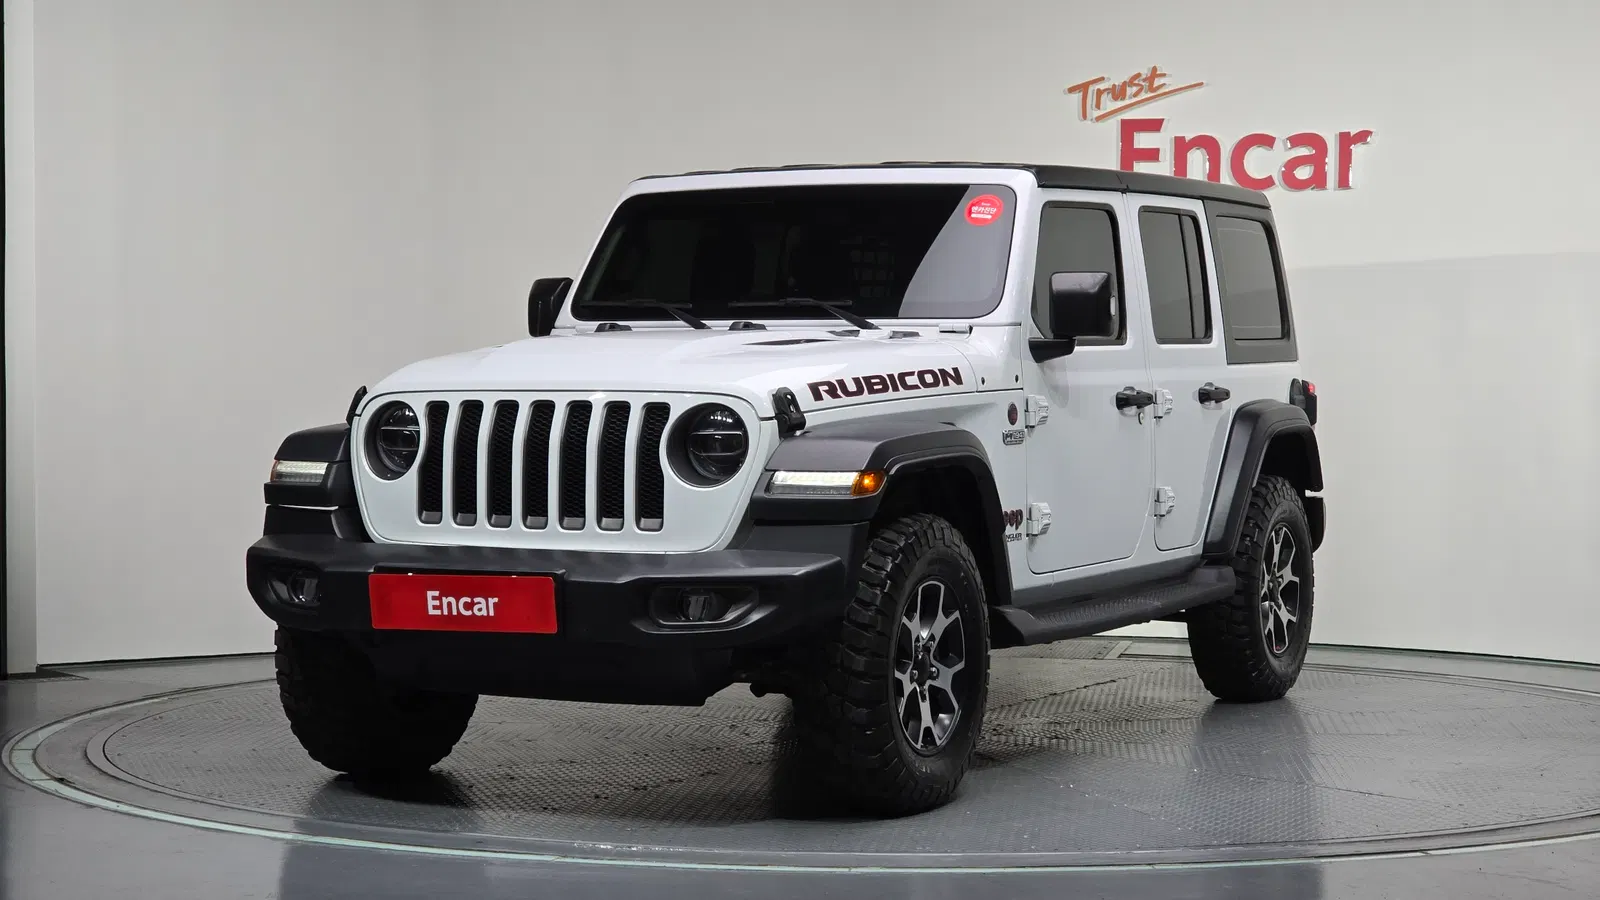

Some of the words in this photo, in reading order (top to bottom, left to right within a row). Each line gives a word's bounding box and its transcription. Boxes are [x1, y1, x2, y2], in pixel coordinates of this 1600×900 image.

[1066, 65, 1168, 121] Trust
[1119, 117, 1375, 191] Encar
[806, 366, 964, 402] RUBICON
[1003, 509, 1024, 531] eep
[426, 590, 499, 616] Encar
